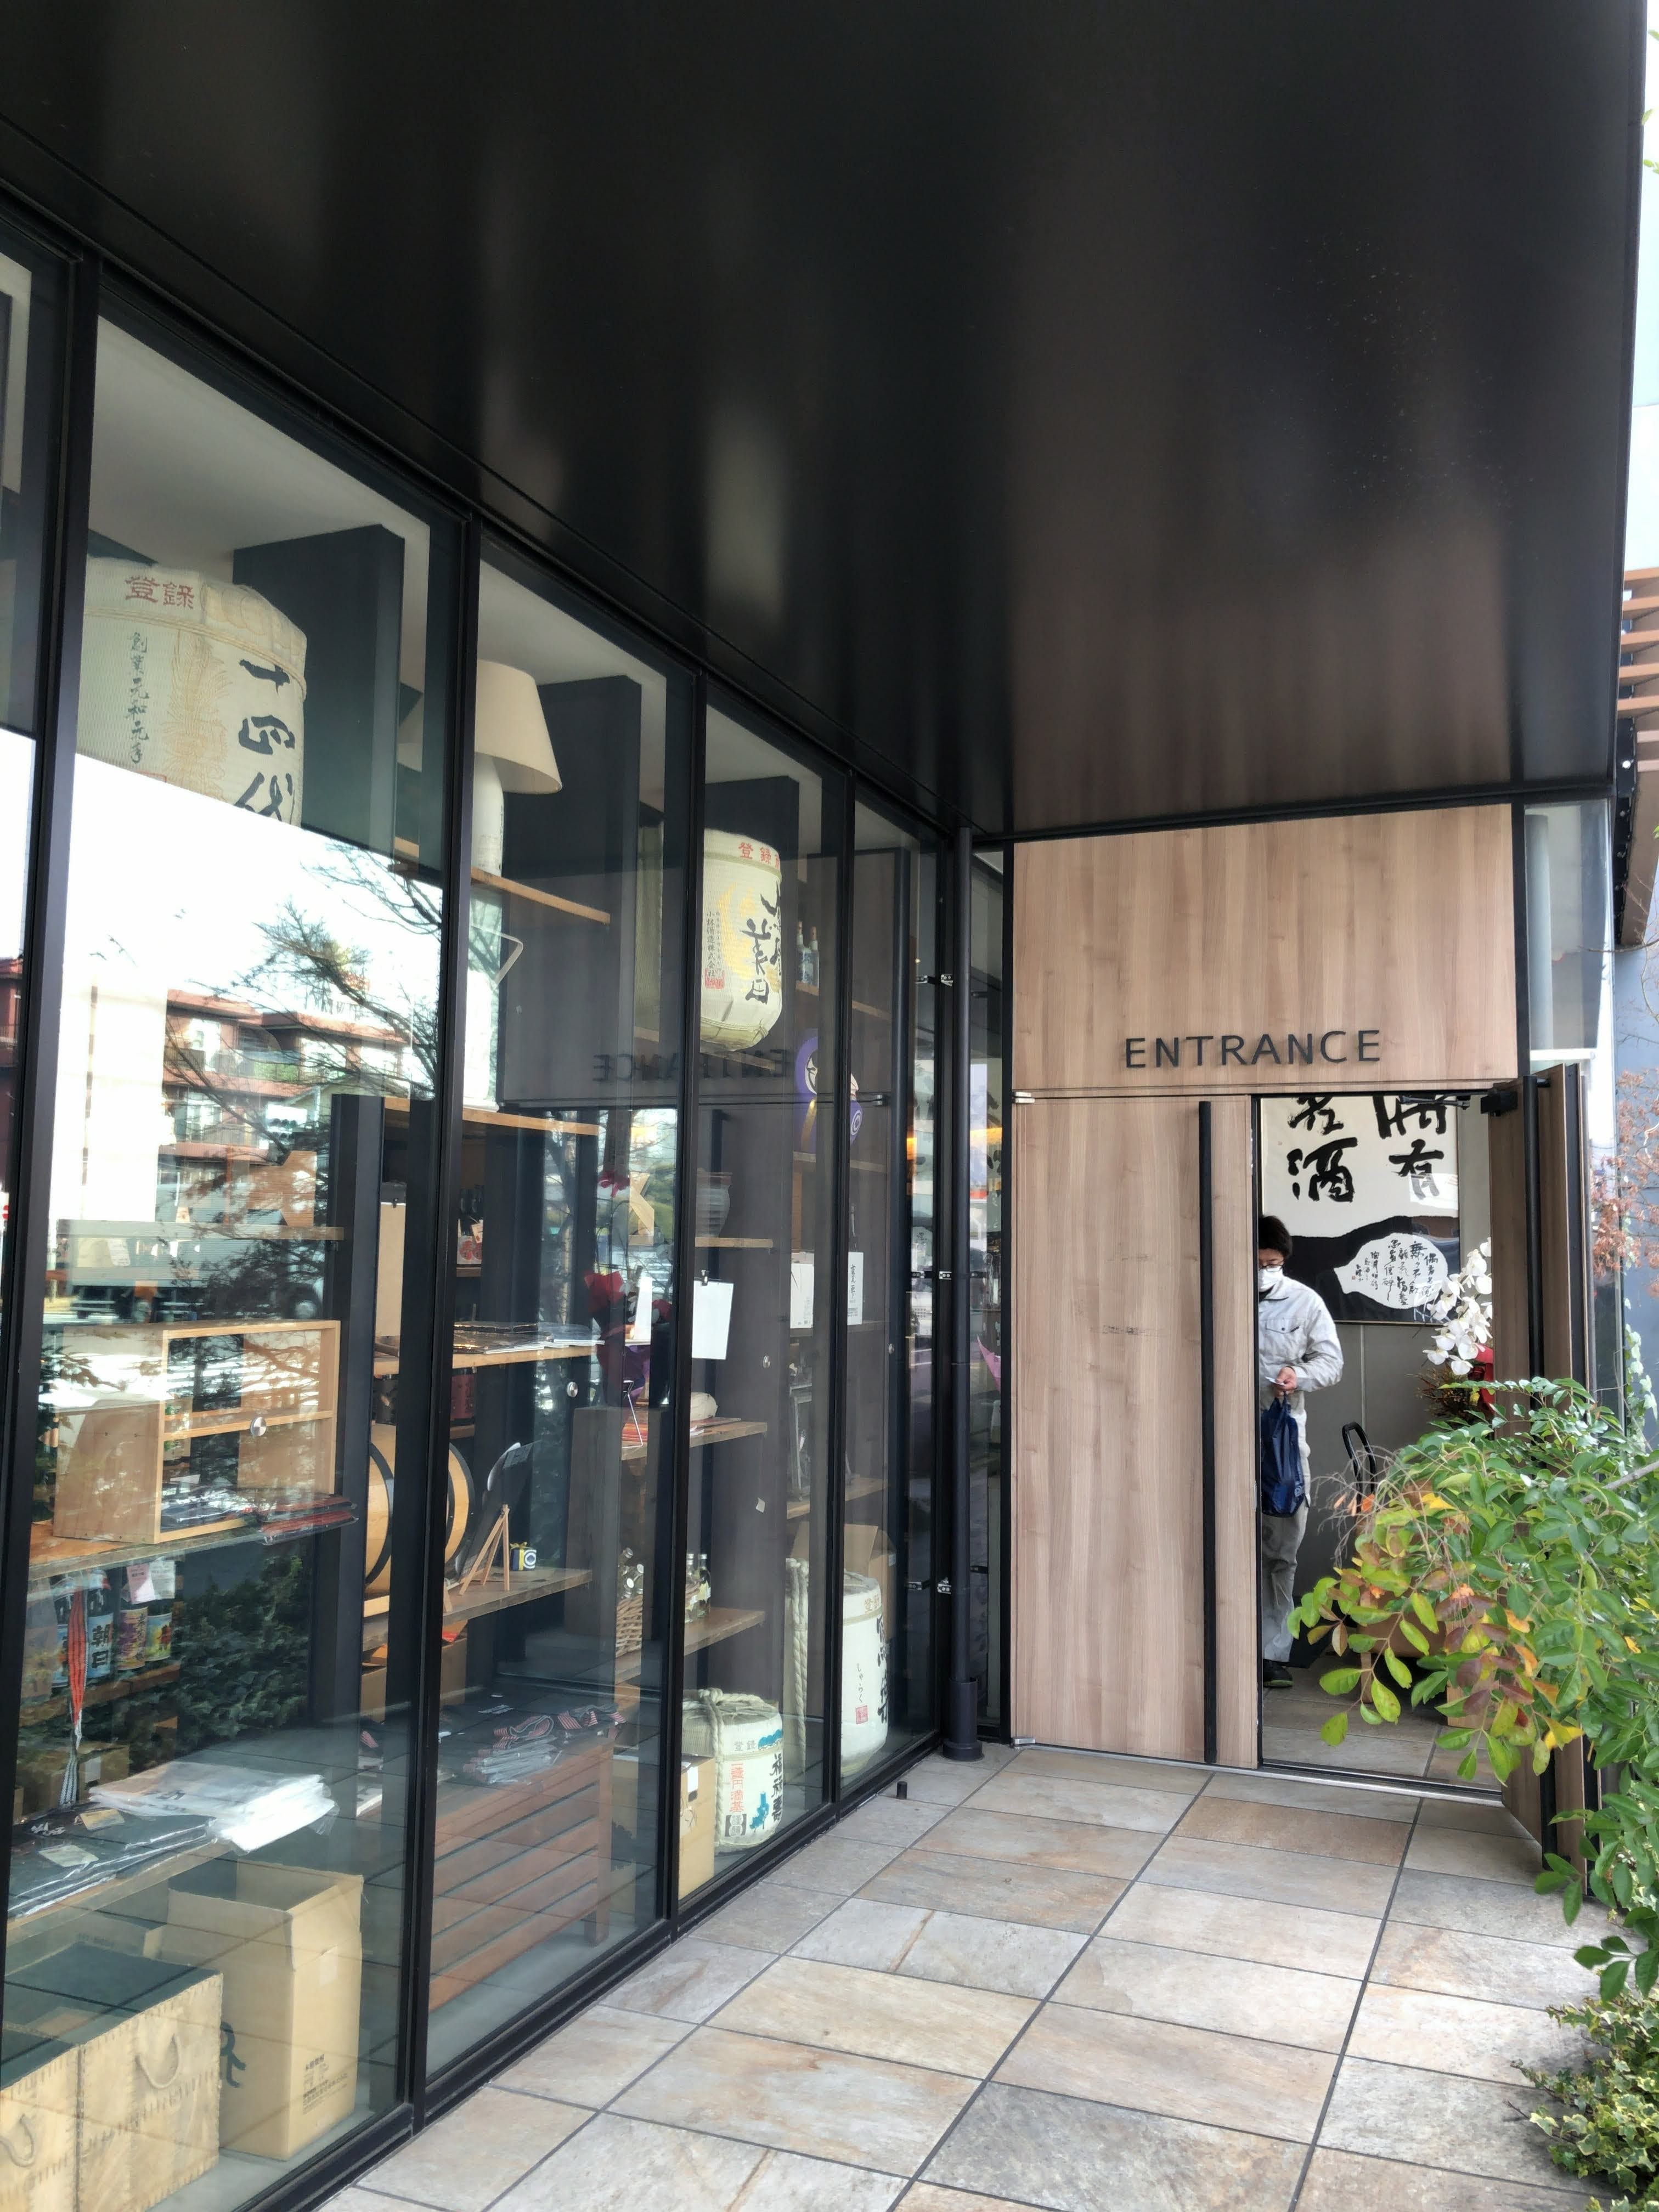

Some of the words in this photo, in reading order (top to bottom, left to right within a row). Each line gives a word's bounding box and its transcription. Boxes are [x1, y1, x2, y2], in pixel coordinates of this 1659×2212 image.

[125, 576, 195, 610] 登録
[1125, 1029, 1380, 1068] ENTRANCE
[92, 1624, 110, 1669] 朝日
